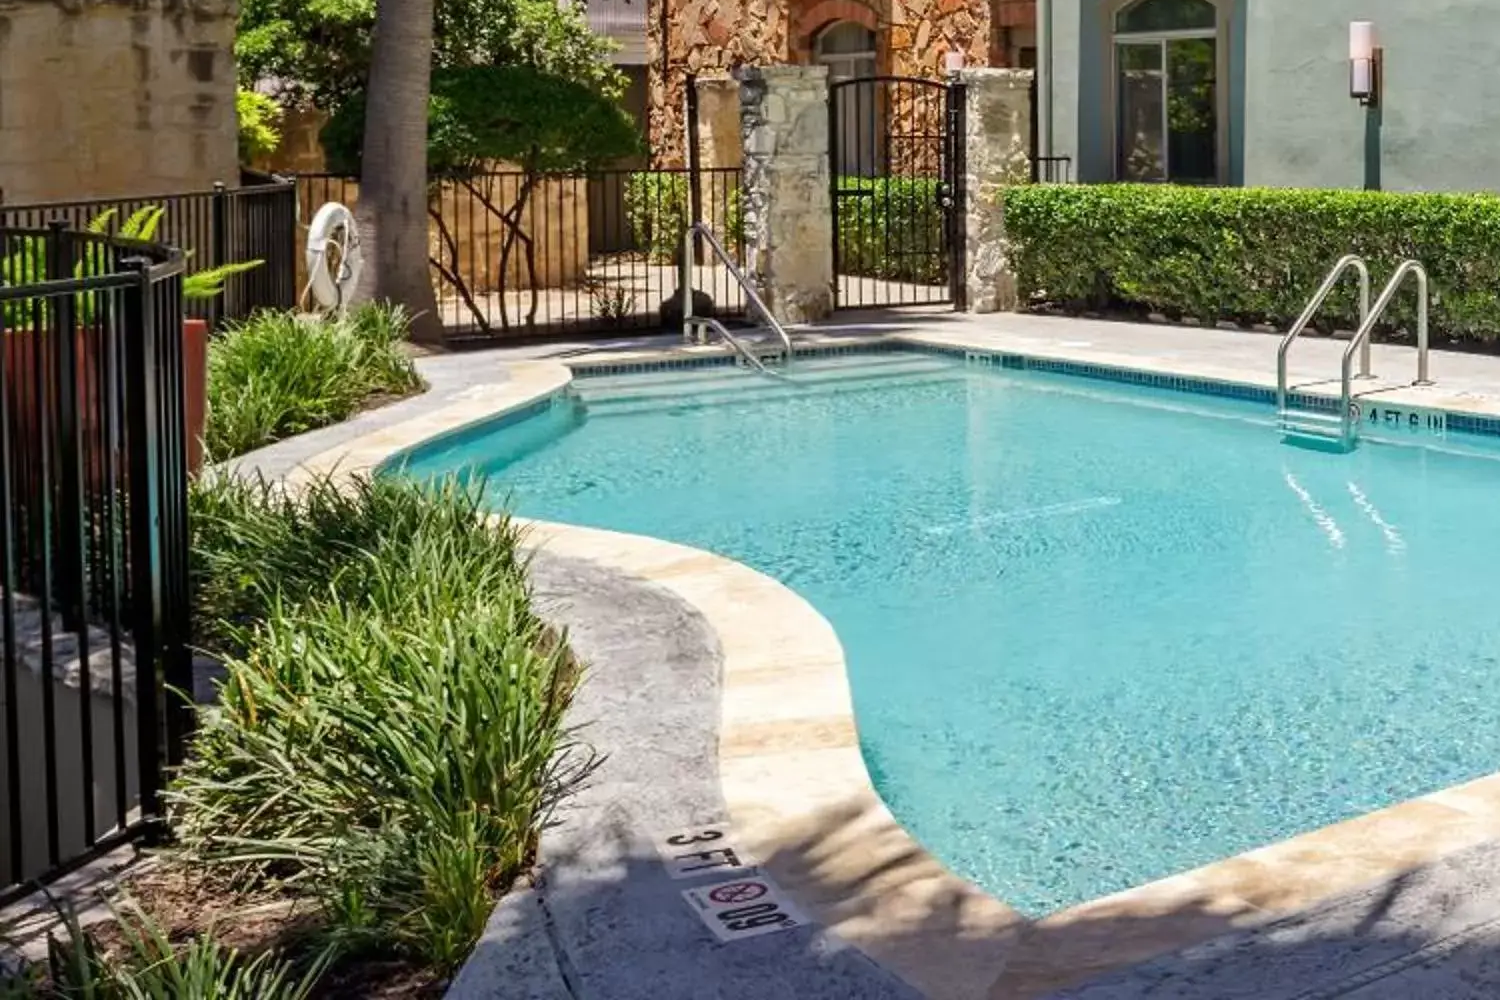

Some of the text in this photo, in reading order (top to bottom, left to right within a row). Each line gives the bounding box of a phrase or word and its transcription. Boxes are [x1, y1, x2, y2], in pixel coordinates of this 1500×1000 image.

[1385, 409, 1401, 423] FT
[1427, 414, 1443, 430] IN
[666, 830, 741, 872] 3 FT
